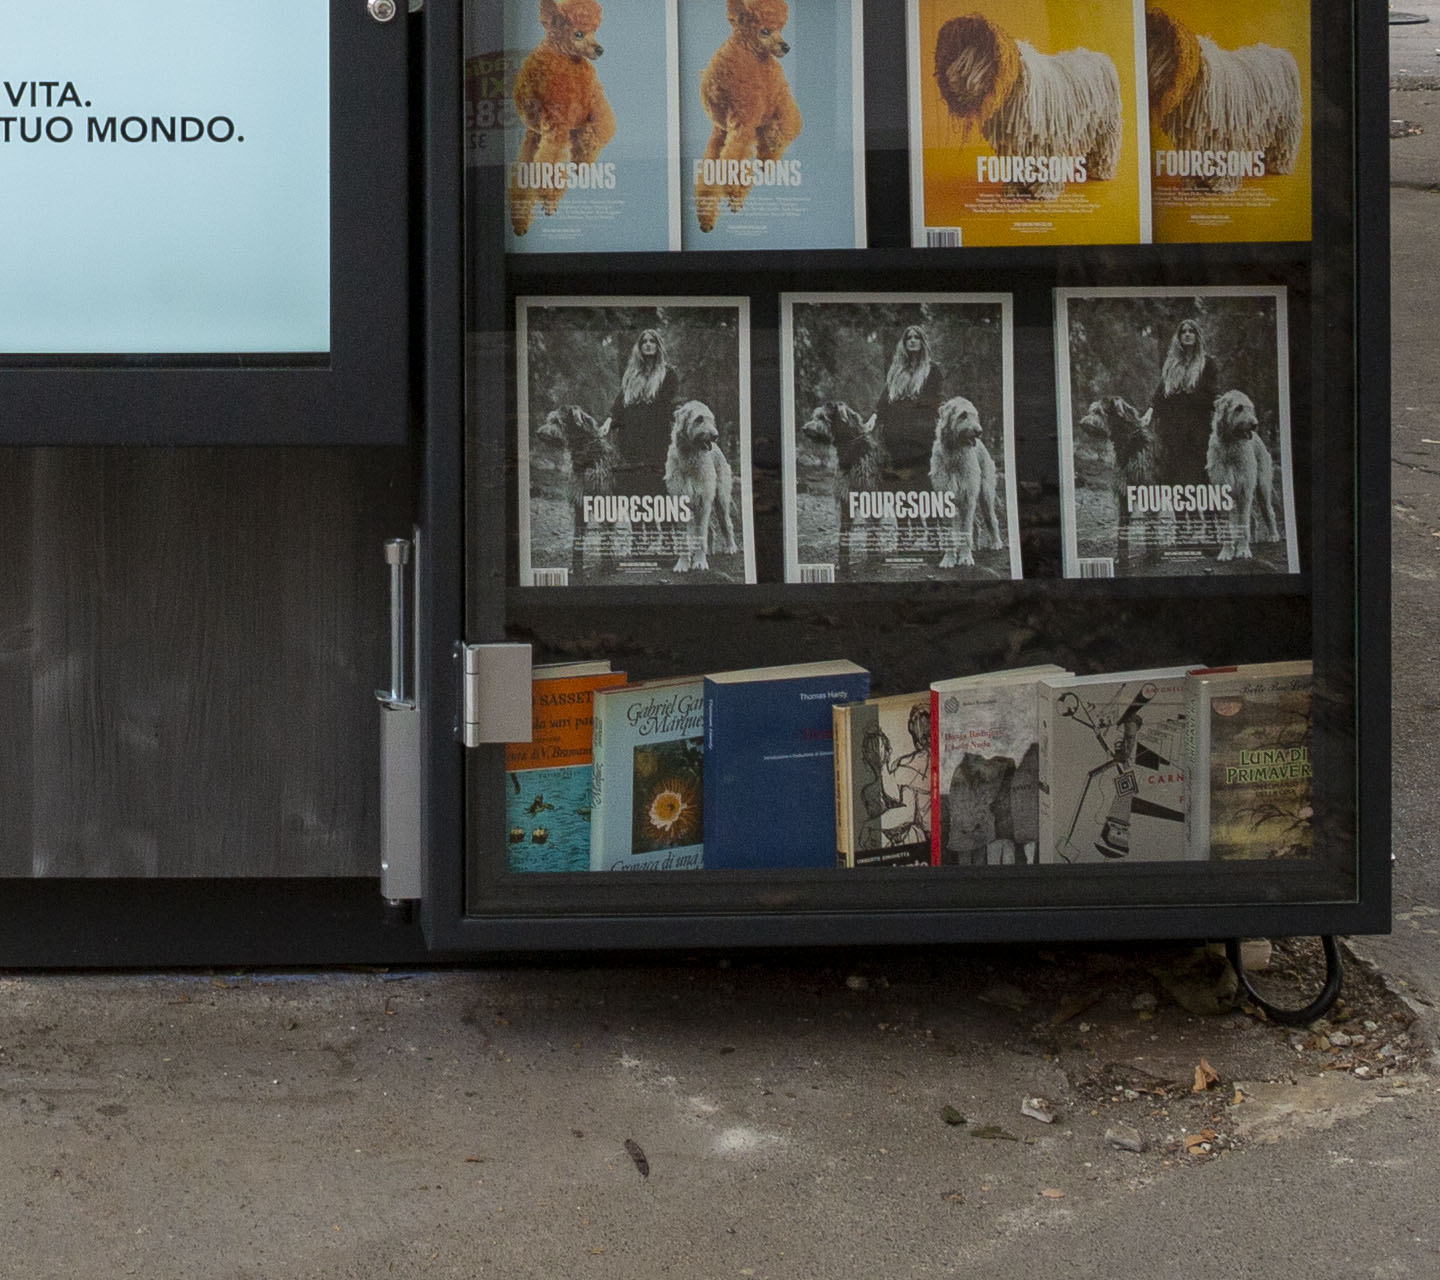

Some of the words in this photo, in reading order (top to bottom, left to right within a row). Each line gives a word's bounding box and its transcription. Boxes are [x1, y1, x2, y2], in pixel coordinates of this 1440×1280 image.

[4, 81, 92, 107] VITA.
[87, 116, 244, 143] MONDO.
[976, 155, 1088, 183] FOUR&SONS
[583, 495, 691, 523] FOUR&SONS
[849, 491, 956, 519] FOUR&SONS
[1127, 484, 1234, 513] FOUR&SONS
[799, 692, 826, 701] Thomas
[827, 690, 848, 700] Hardy
[627, 694, 678, 727] Gabriel
[1240, 748, 1286, 766] LUNA
[1289, 746, 1308, 762] DI
[1226, 763, 1312, 785] PRIMAVER
